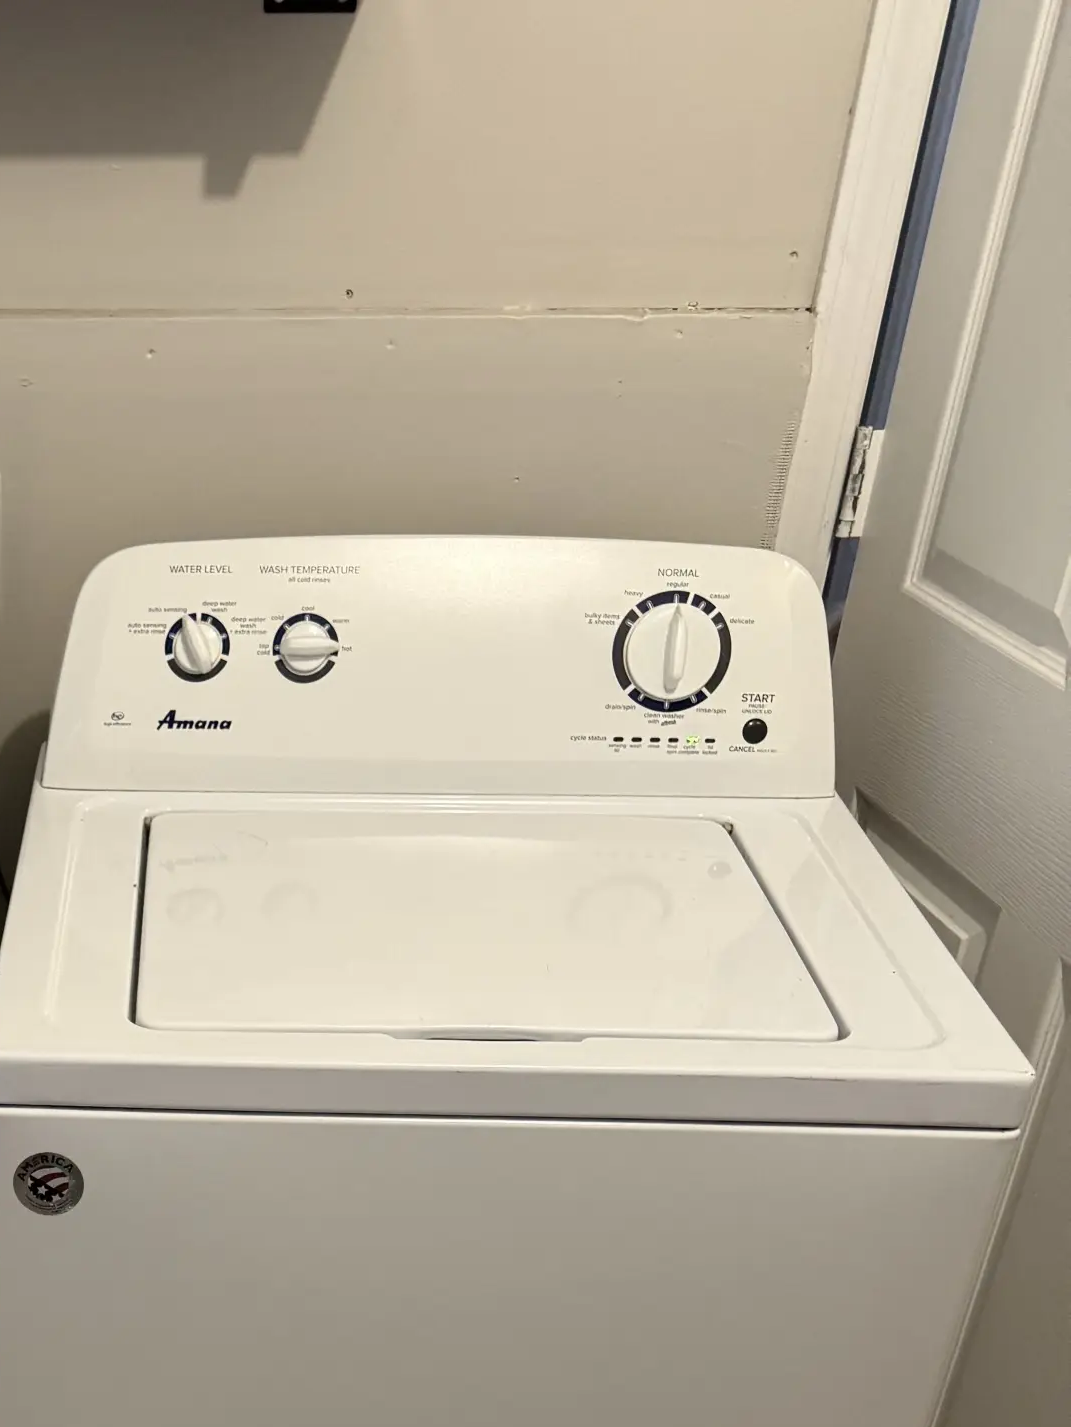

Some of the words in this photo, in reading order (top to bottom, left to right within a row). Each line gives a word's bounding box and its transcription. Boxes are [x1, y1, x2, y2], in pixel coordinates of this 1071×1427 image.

[169, 565, 202, 574] WATER
[205, 565, 233, 574] LEVEL
[259, 565, 288, 575] WASH
[291, 565, 361, 575] TEMPERATURE
[658, 568, 700, 577] NORMAL
[585, 612, 601, 620] bulky
[741, 693, 775, 703] START
[157, 710, 232, 730] Amana
[17, 1155, 74, 1182] AMERICA
